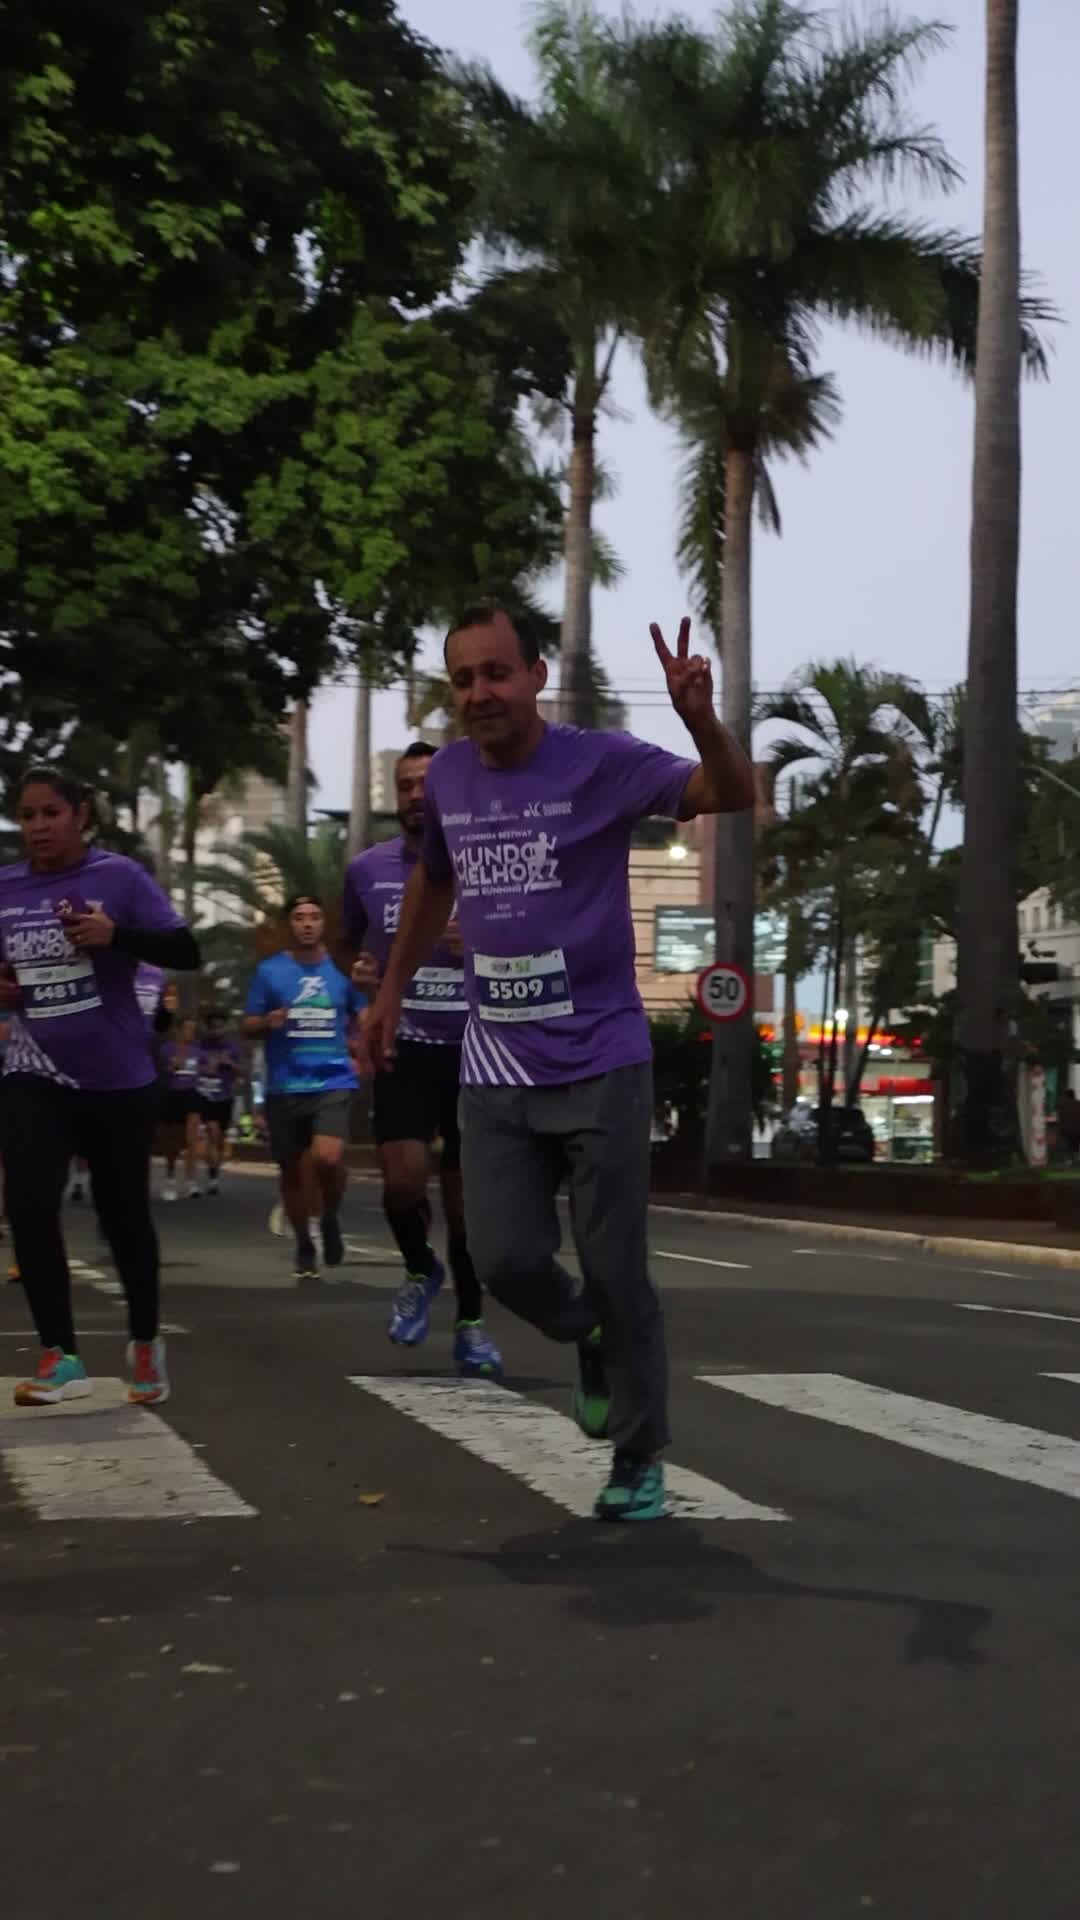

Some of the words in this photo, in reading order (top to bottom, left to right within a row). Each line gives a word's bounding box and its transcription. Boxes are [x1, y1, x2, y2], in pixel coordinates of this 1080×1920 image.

[452, 842, 541, 870] MUNDO
[33, 982, 77, 1001] 6481
[415, 983, 457, 996] 5306
[489, 979, 544, 1000] 5509
[709, 976, 739, 1000] 50
